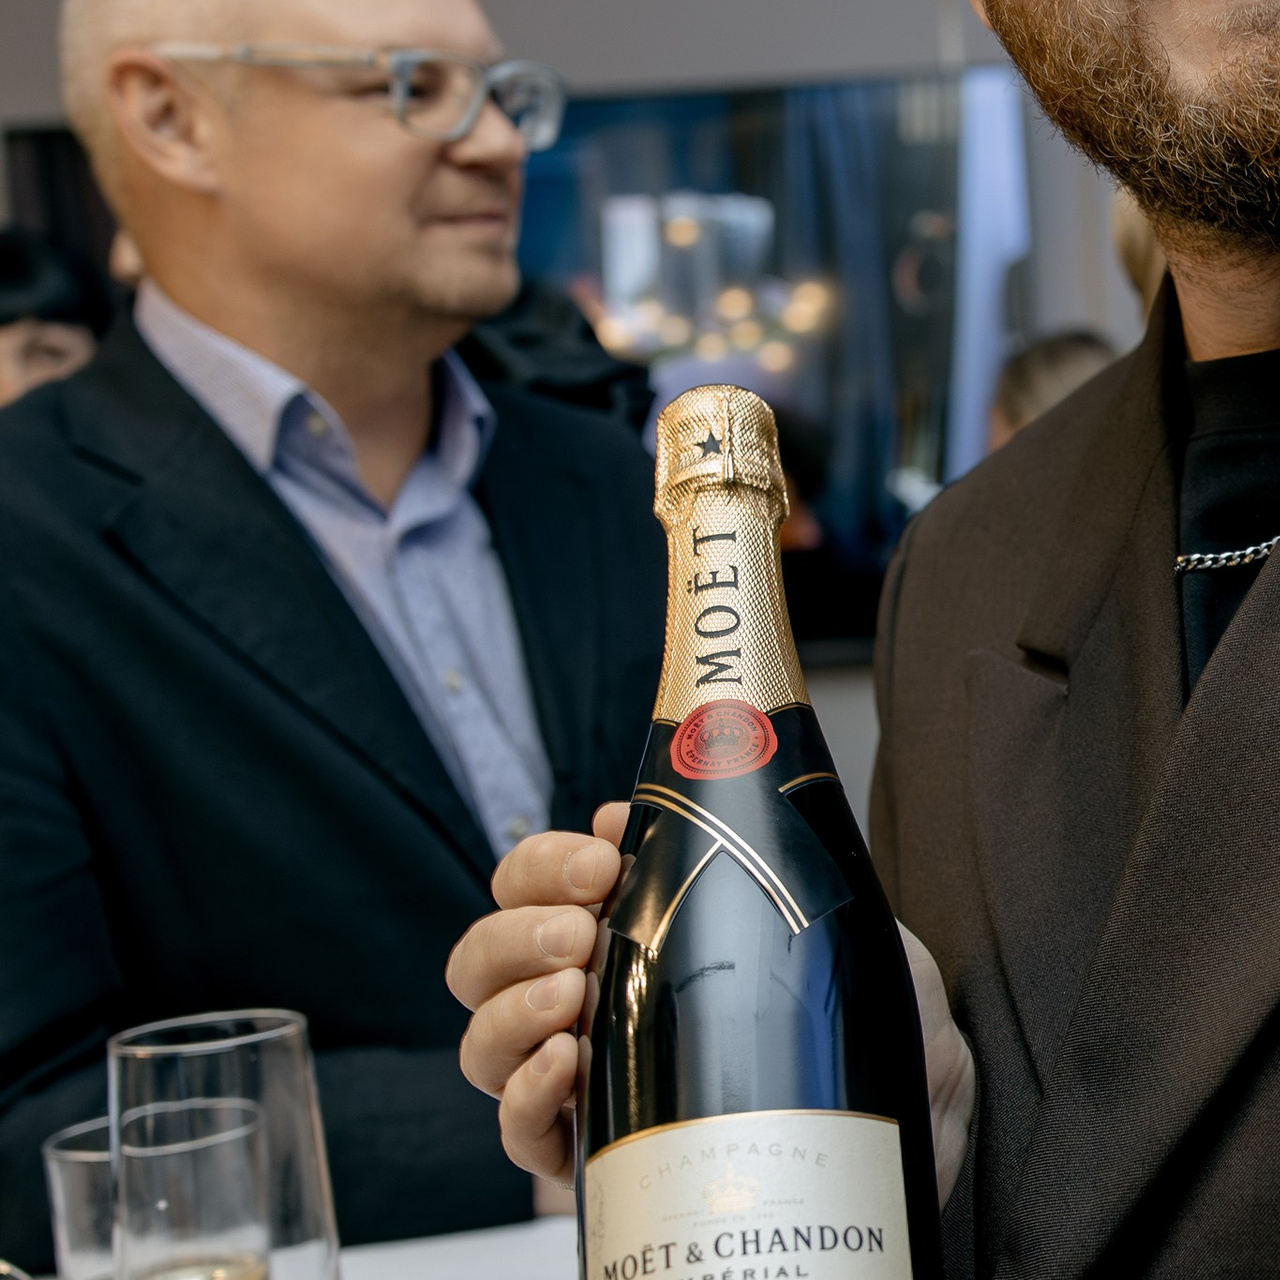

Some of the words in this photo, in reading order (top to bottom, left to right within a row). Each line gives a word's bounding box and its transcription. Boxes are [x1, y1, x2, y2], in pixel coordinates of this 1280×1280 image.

[687, 527, 742, 687] MOËT
[716, 710, 758, 732] CHANDON
[726, 743, 760, 765] FRANCE
[638, 1143, 830, 1190] CHAMPAGNE
[686, 1242, 704, 1264] &
[714, 1225, 885, 1259] CHANDON
